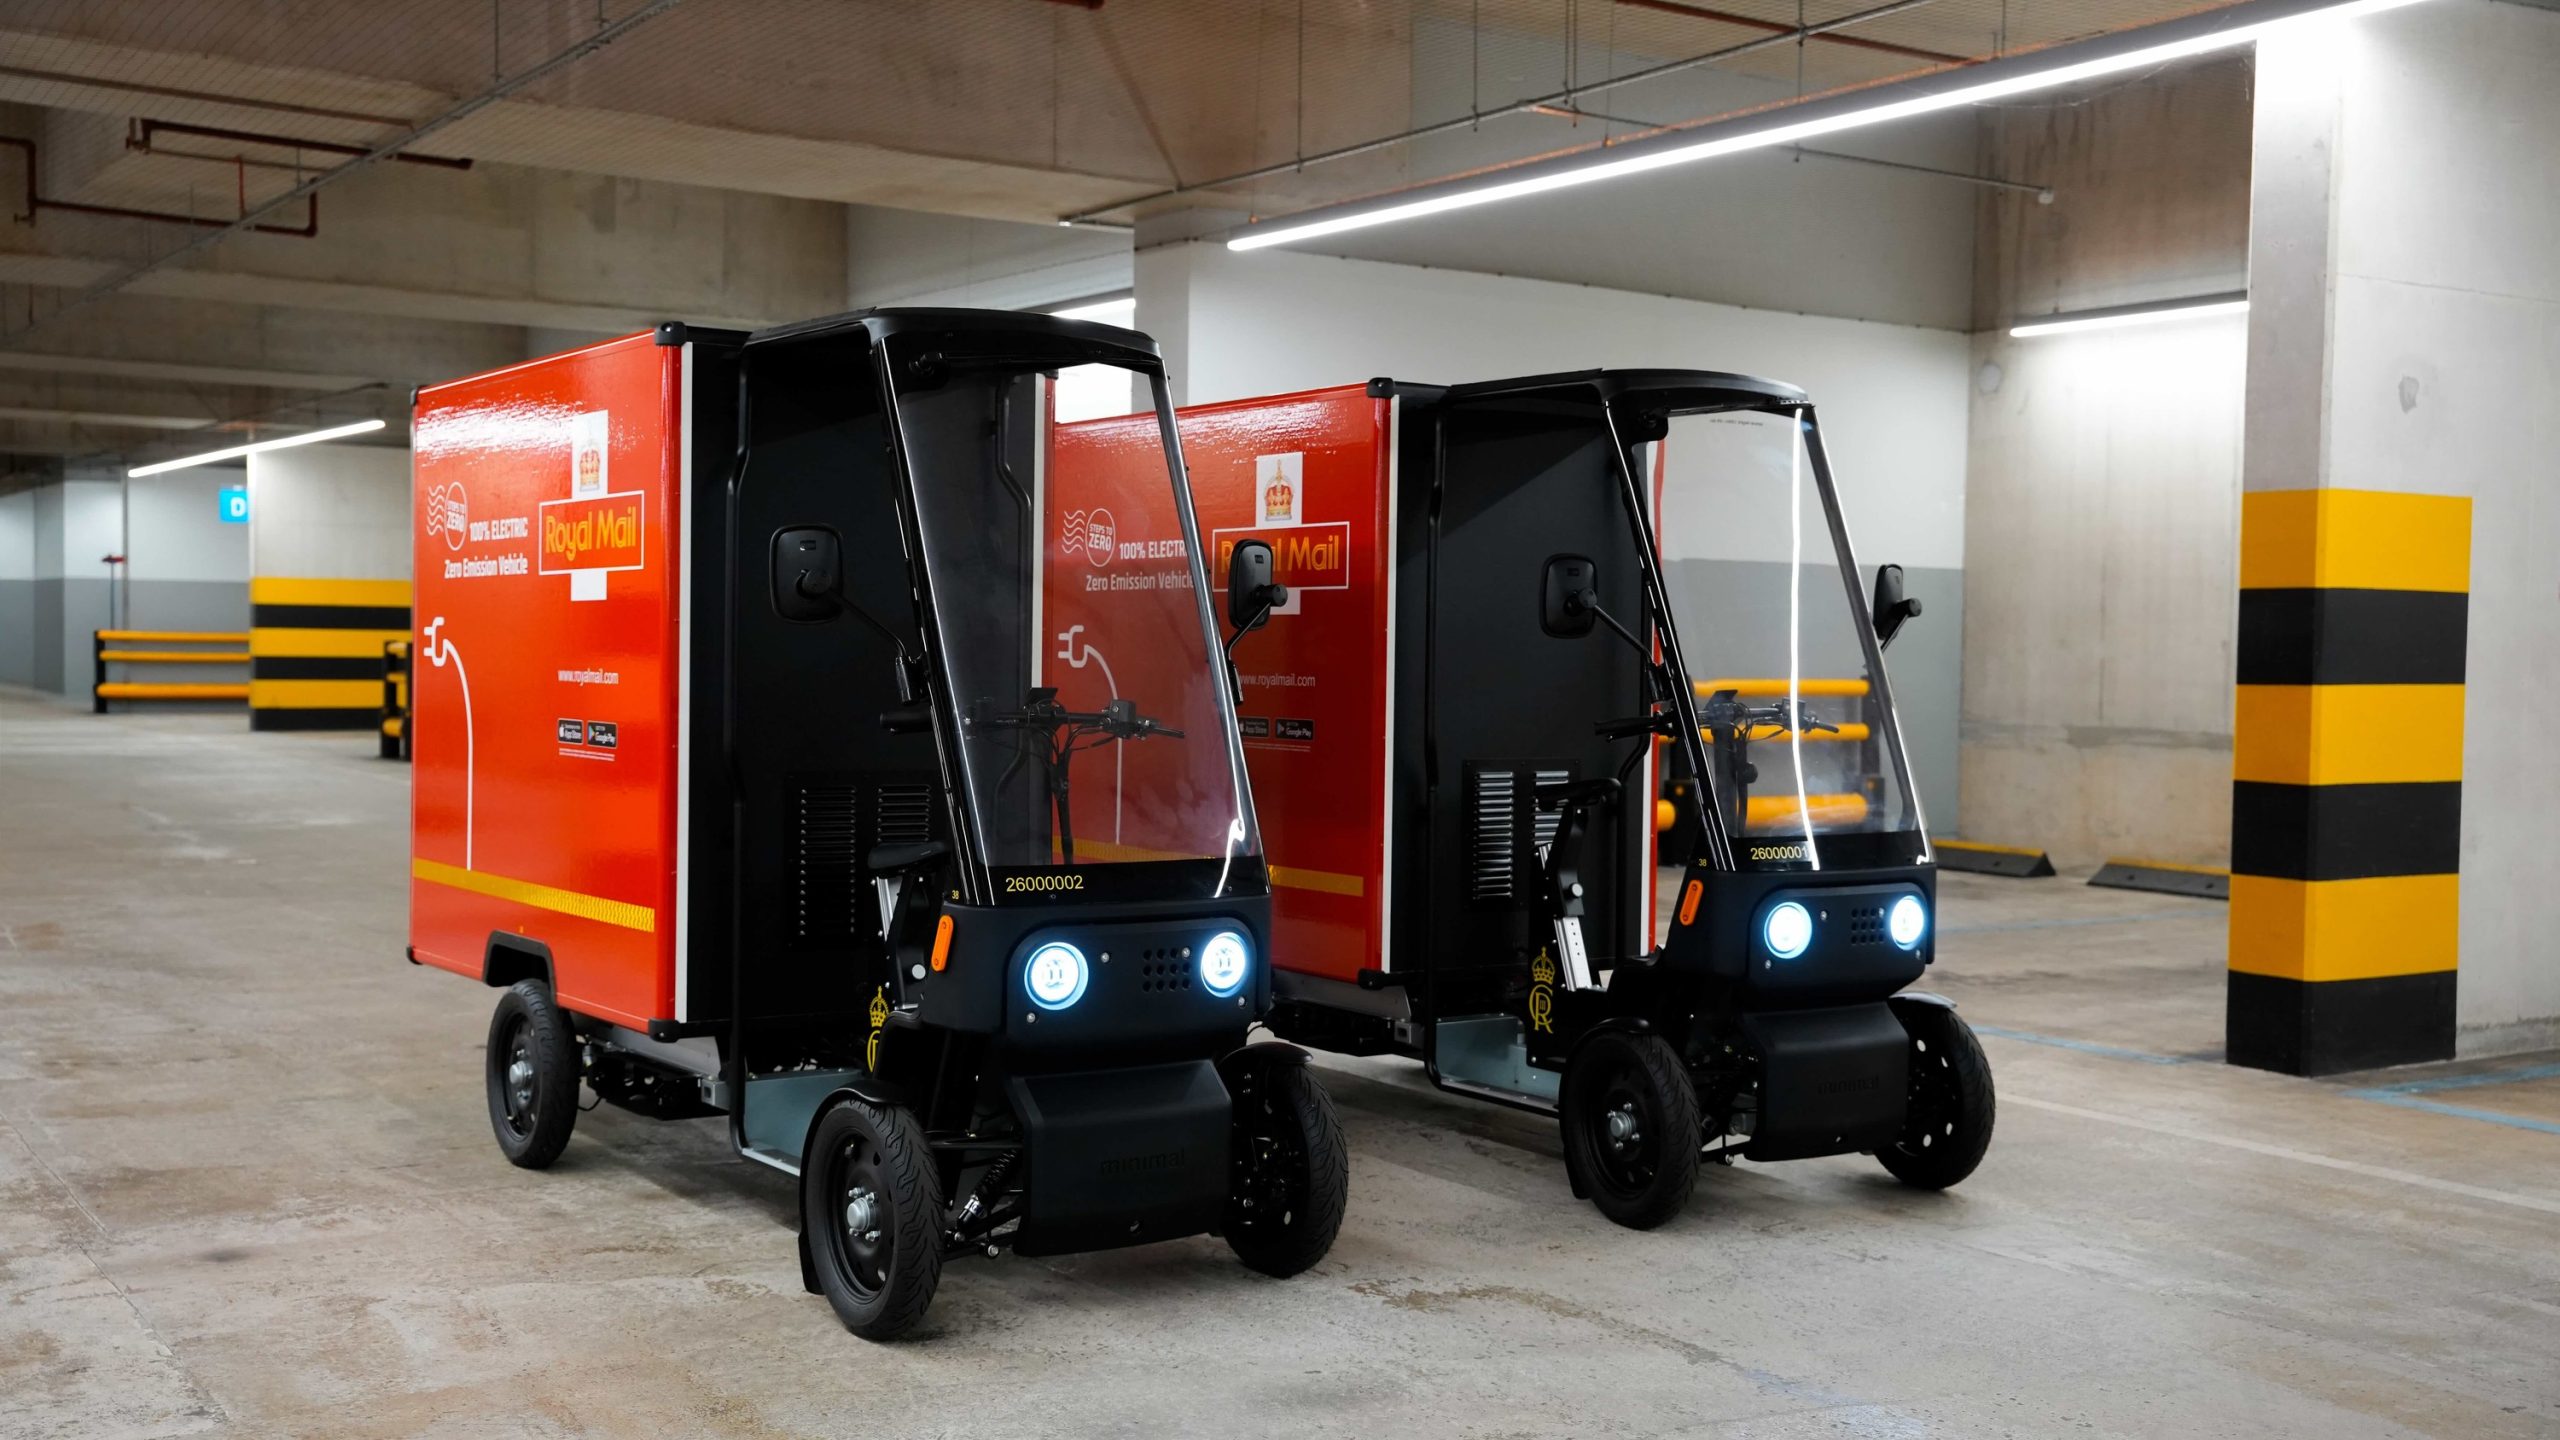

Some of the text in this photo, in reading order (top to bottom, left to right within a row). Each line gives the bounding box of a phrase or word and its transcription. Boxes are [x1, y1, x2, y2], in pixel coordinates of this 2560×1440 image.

[469, 517, 528, 542] 100% ELECTRIC
[545, 506, 636, 562] Royal Mail
[1089, 523, 1113, 536] STEPS TO
[1088, 532, 1112, 552] ZERO
[1119, 540, 1187, 560] 100% ELECTR
[1288, 535, 1339, 571] Mail
[444, 552, 528, 579] Zero Emission Vehicle
[1085, 574, 1108, 592] Zero
[1110, 572, 1155, 591] Emission
[1698, 858, 1707, 867] 38
[1750, 846, 1808, 860] 26000001
[1005, 875, 1084, 892] 26000002
[951, 889, 960, 900] 38
[1100, 1147, 1185, 1176] minimal
